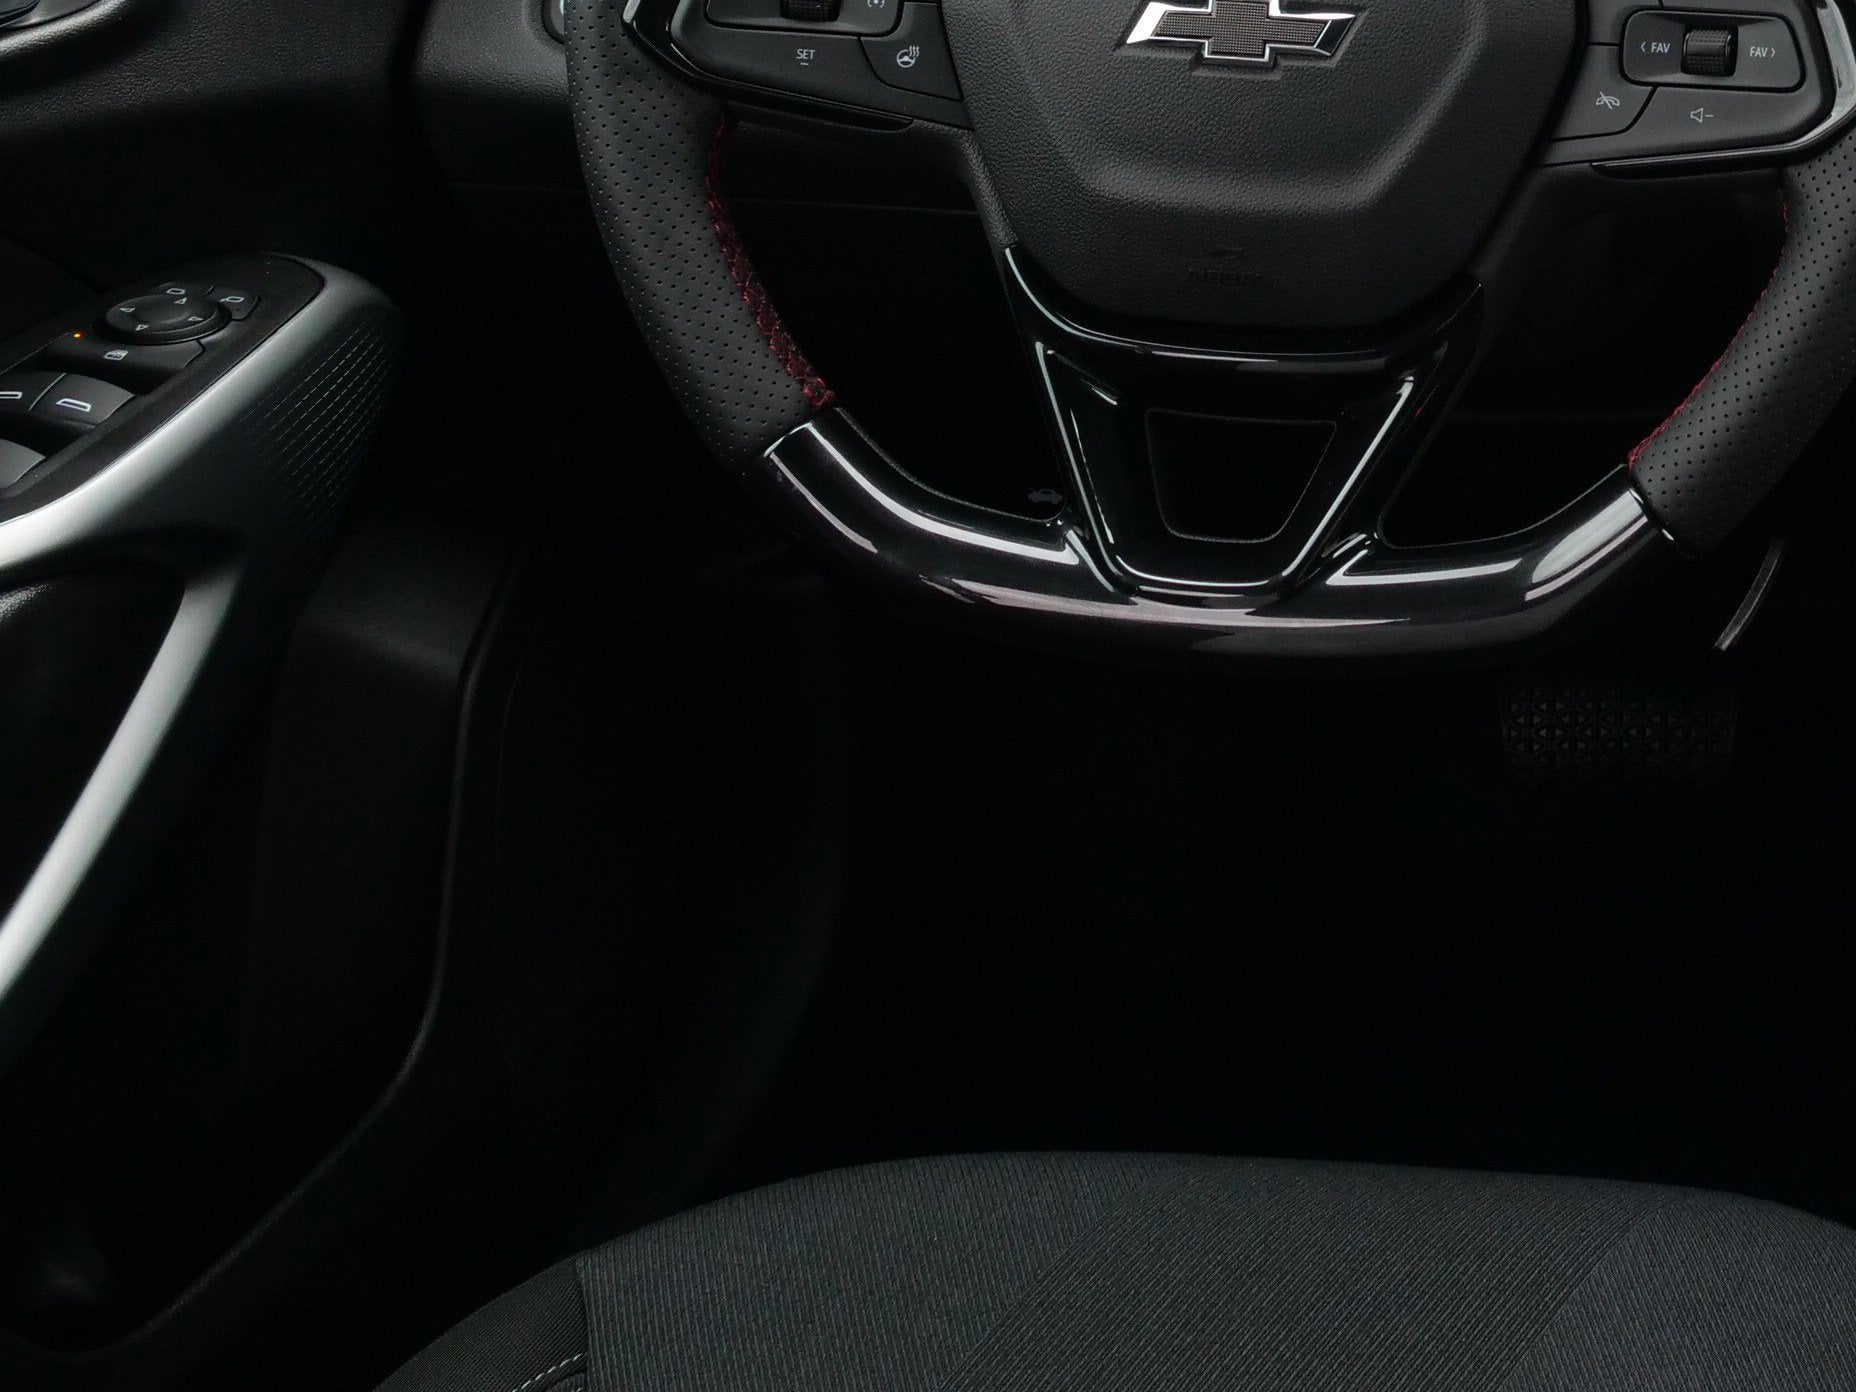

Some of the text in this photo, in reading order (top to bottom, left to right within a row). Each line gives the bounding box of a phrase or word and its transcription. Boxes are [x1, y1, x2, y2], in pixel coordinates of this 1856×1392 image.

[796, 48, 816, 60] SET
[1651, 42, 1671, 54] FAV
[1750, 47, 1768, 58] FAV
